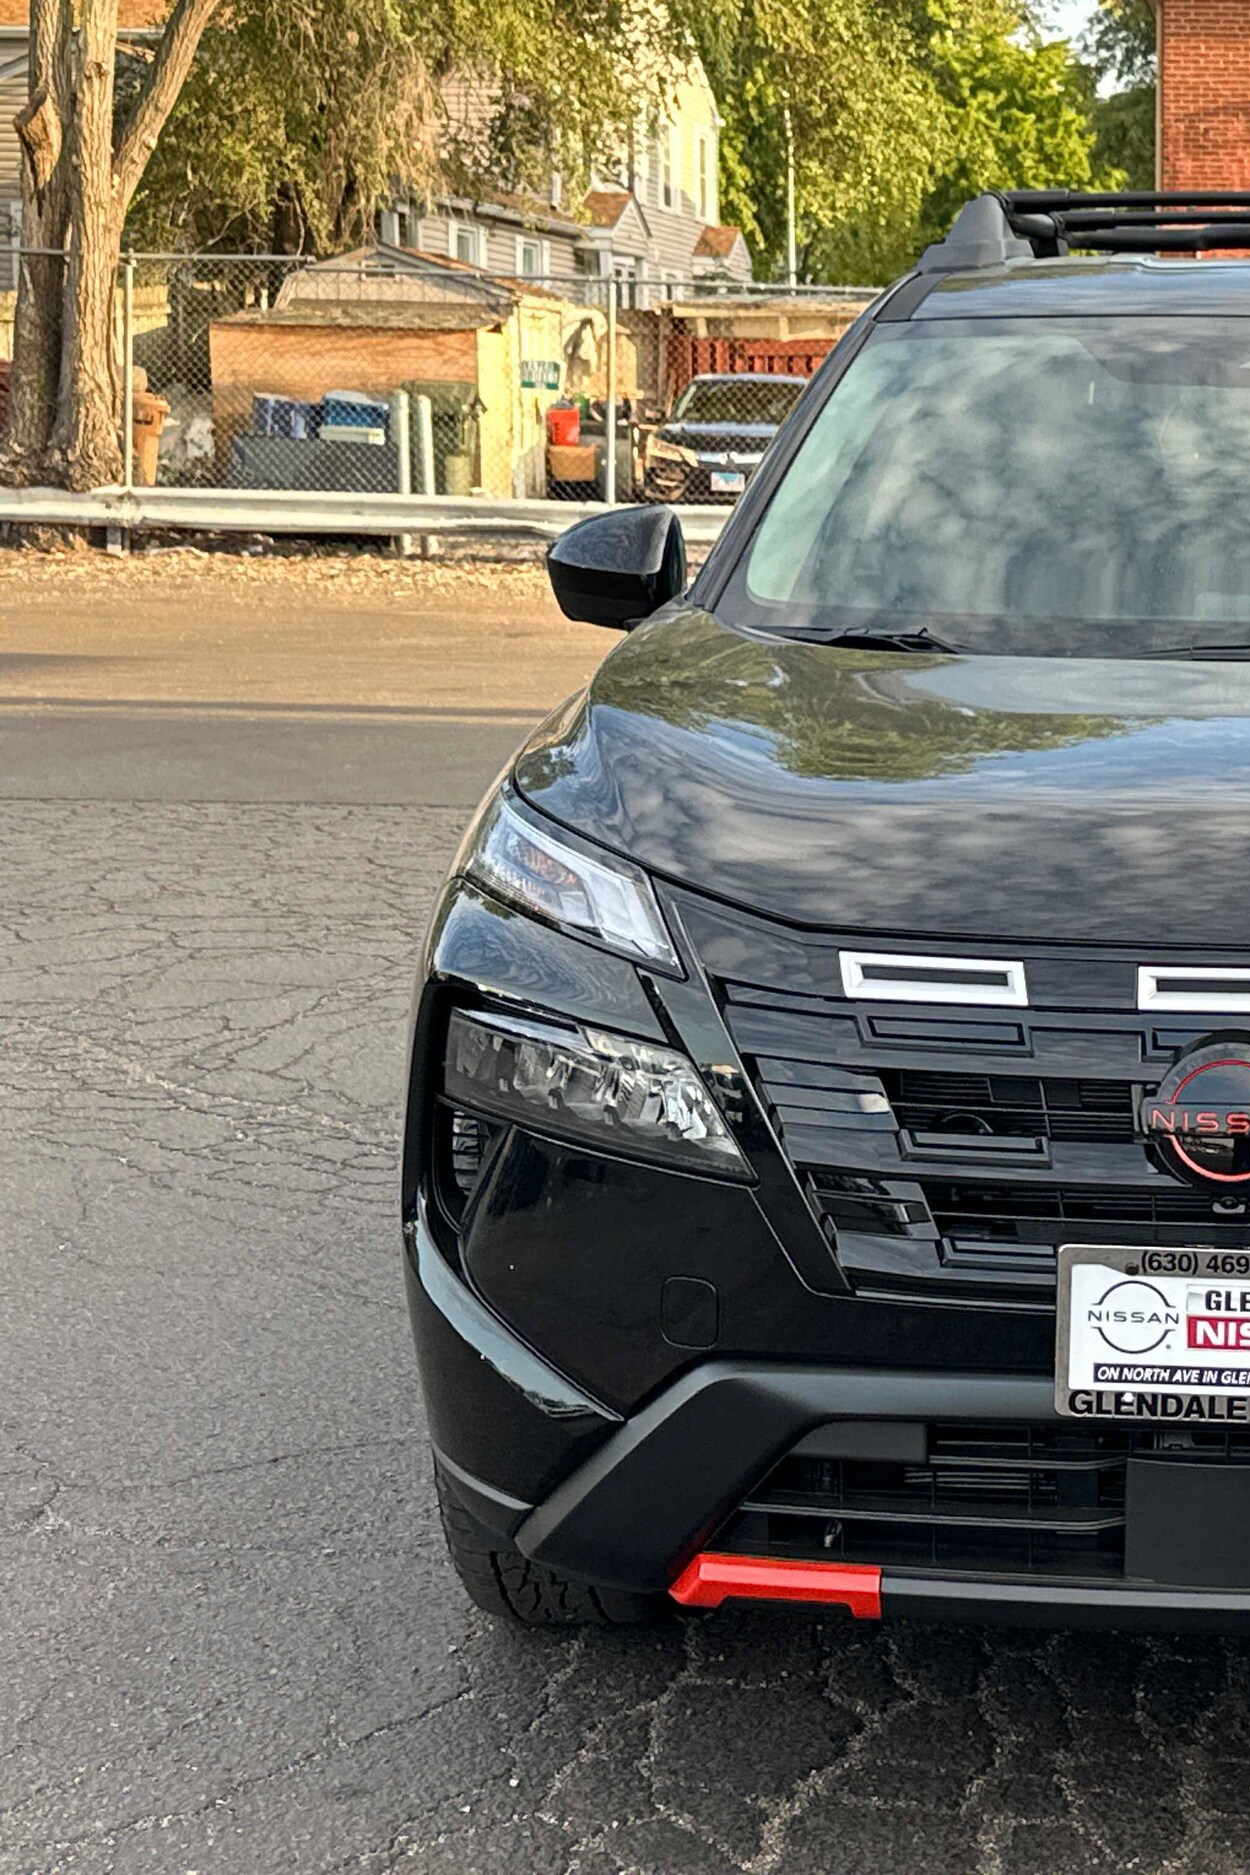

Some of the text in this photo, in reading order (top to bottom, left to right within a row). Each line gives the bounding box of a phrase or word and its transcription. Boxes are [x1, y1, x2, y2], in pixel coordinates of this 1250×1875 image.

[1141, 1250, 1198, 1275] (630)
[1088, 1310, 1180, 1325] NISSAN
[1097, 1366, 1120, 1380] ON
[1122, 1367, 1171, 1382] NORTH
[1172, 1369, 1200, 1383] AVE
[1202, 1370, 1218, 1384] IN
[1068, 1389, 1248, 1420] GLENDALE
